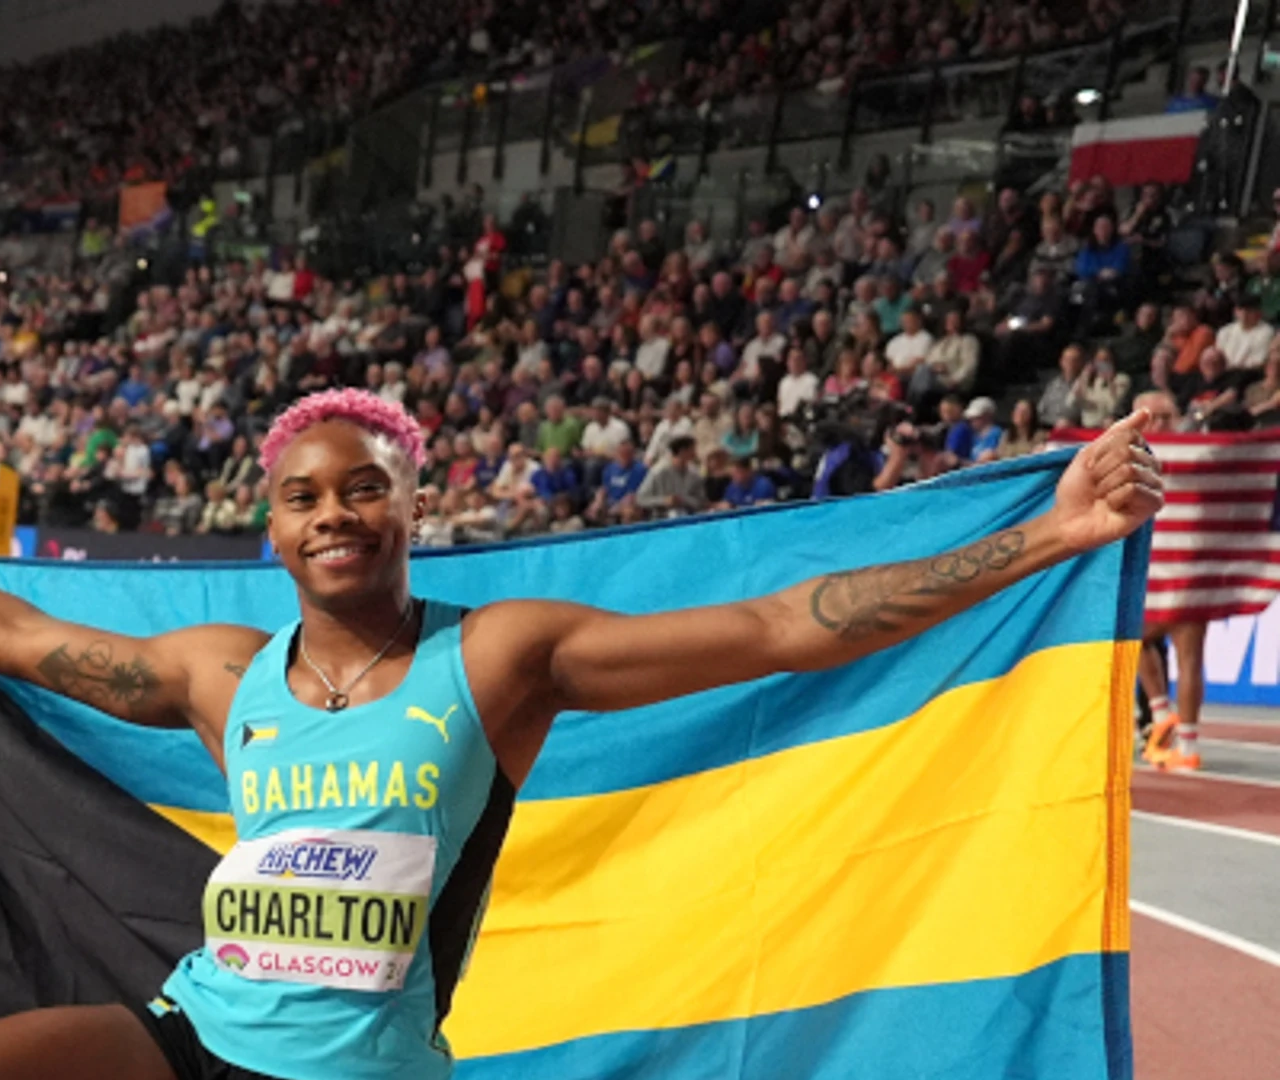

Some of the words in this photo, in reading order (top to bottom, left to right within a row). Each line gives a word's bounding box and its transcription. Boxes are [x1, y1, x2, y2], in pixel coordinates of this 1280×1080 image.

[241, 761, 440, 815] BAHAMAS
[216, 888, 417, 945] CHARLTON
[258, 952, 380, 977] GLASGOW
